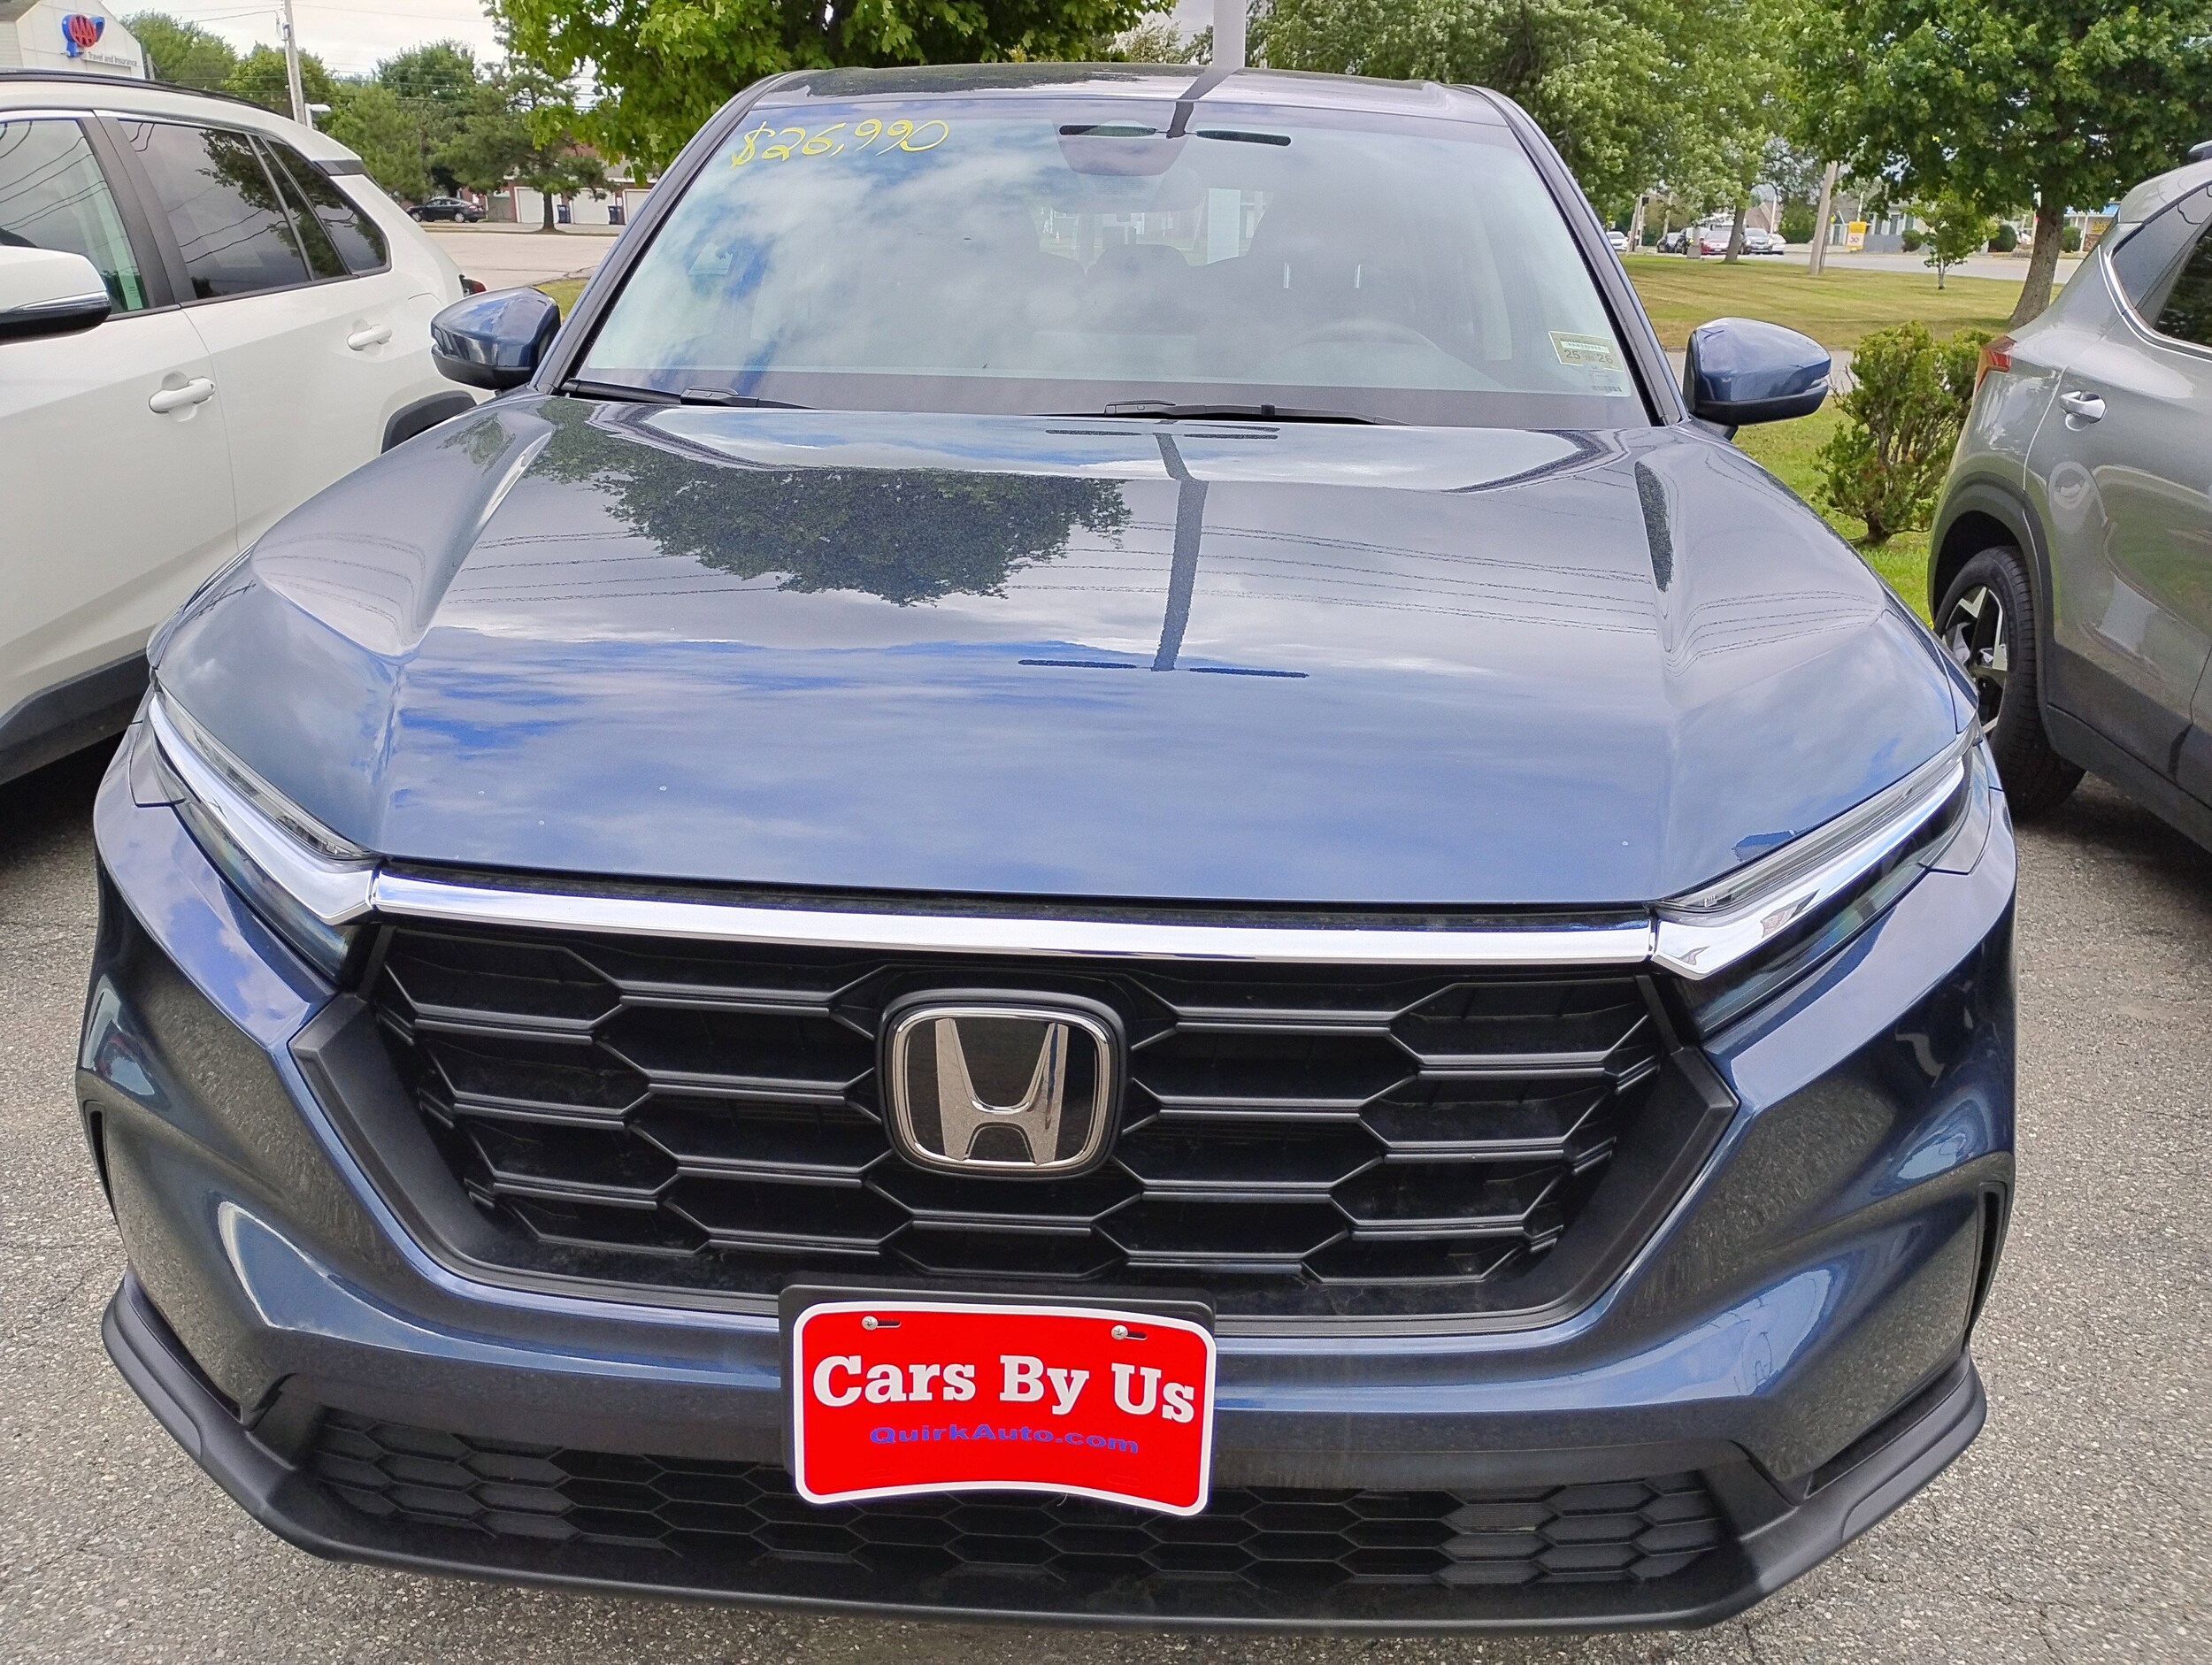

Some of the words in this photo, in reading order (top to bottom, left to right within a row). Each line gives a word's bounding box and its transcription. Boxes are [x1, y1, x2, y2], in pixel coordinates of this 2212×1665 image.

[114, 56, 137, 66] Insurance
[730, 118, 949, 170] $26,990
[1563, 349, 1581, 360] 25
[1596, 353, 1614, 364] 26
[812, 1354, 977, 1408] Cars
[999, 1354, 1090, 1415] By
[1110, 1362, 1195, 1423] Us
[870, 1423, 1139, 1454] QuirkAuto.com
